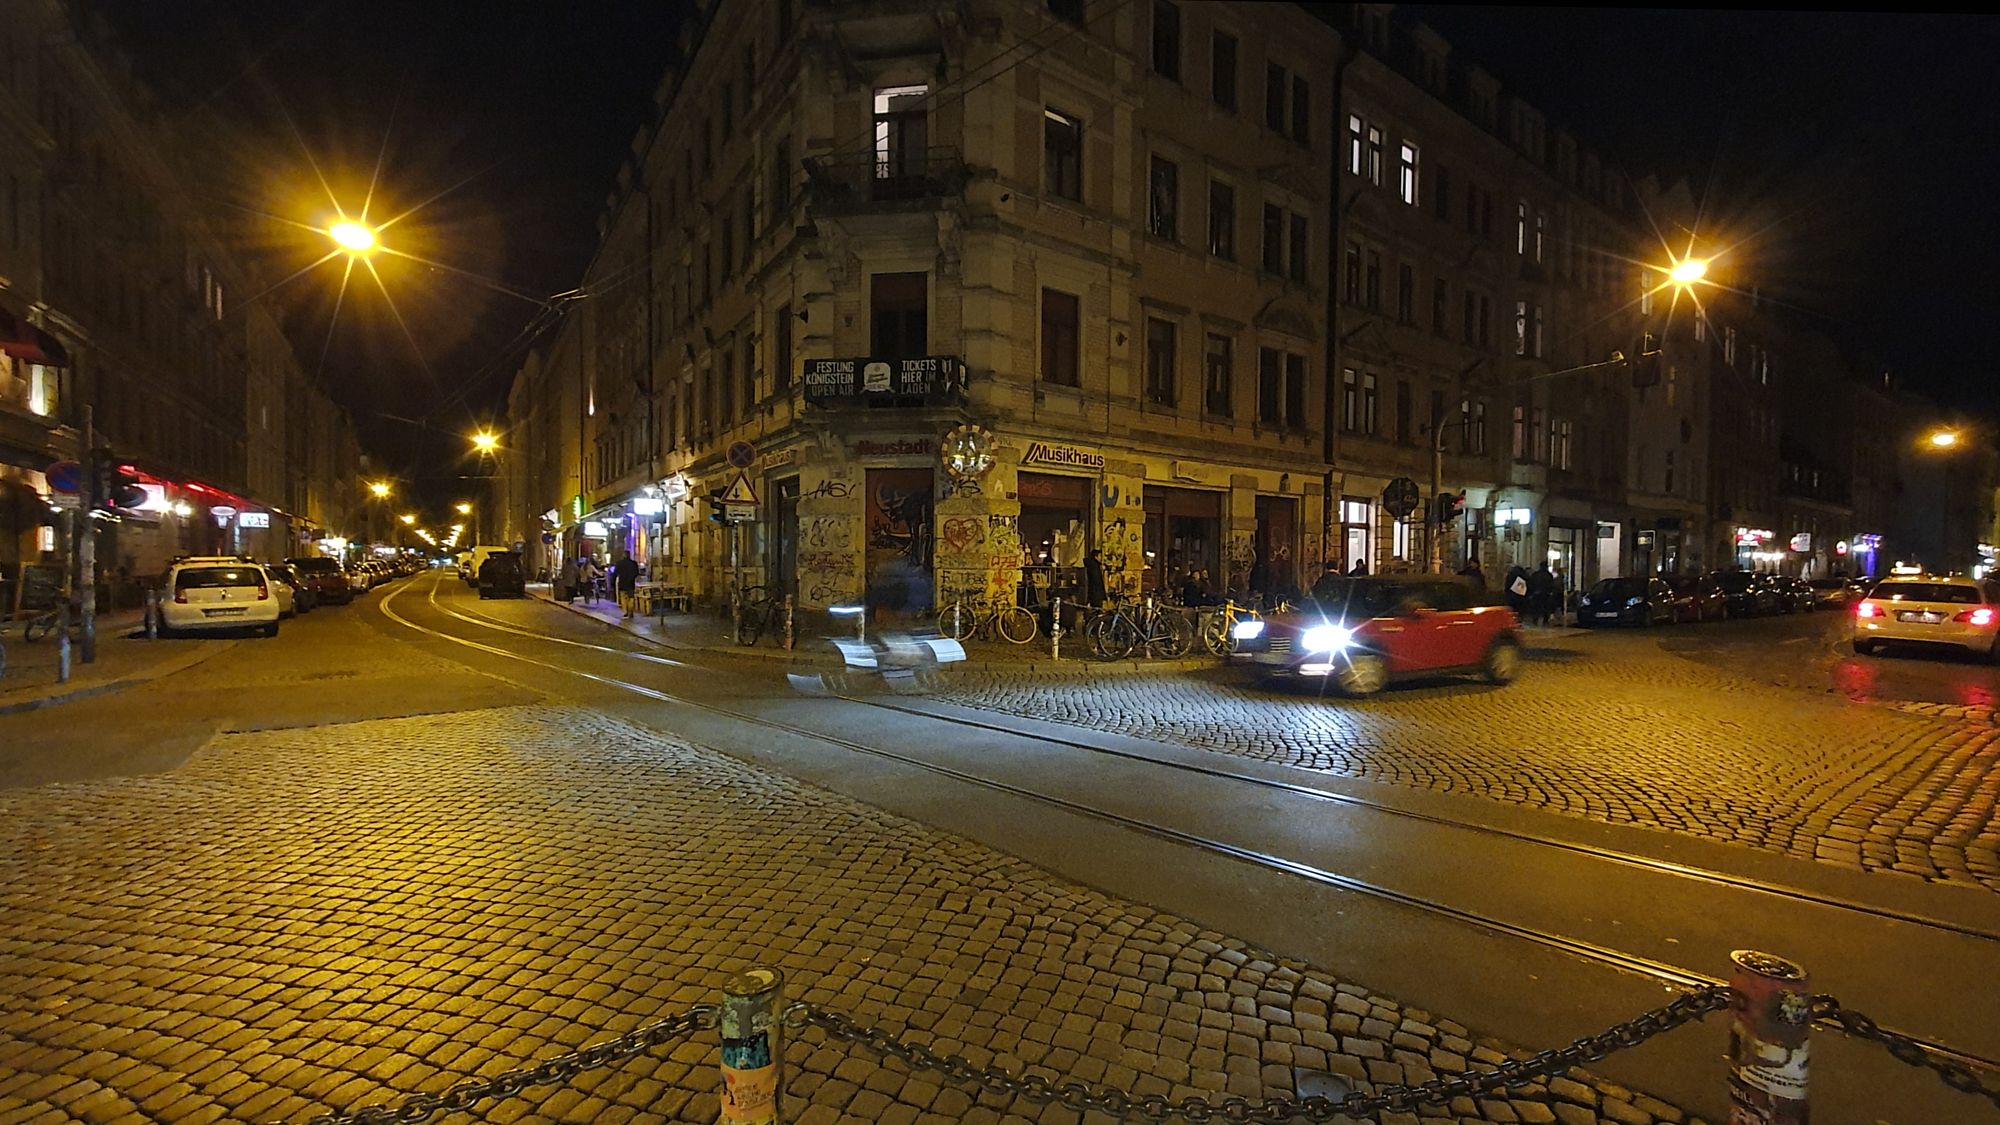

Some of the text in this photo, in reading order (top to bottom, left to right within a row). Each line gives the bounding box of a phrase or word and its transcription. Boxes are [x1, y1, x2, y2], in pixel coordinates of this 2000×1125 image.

[816, 361, 855, 373] FESTUNG
[901, 359, 936, 372] TICKETS
[805, 372, 854, 385] KÖNIGSTEIN
[901, 371, 923, 383] HIER
[811, 384, 855, 397] OPEN AIR
[901, 383, 931, 395] LADEN
[1025, 444, 1104, 466] Musikhaus
